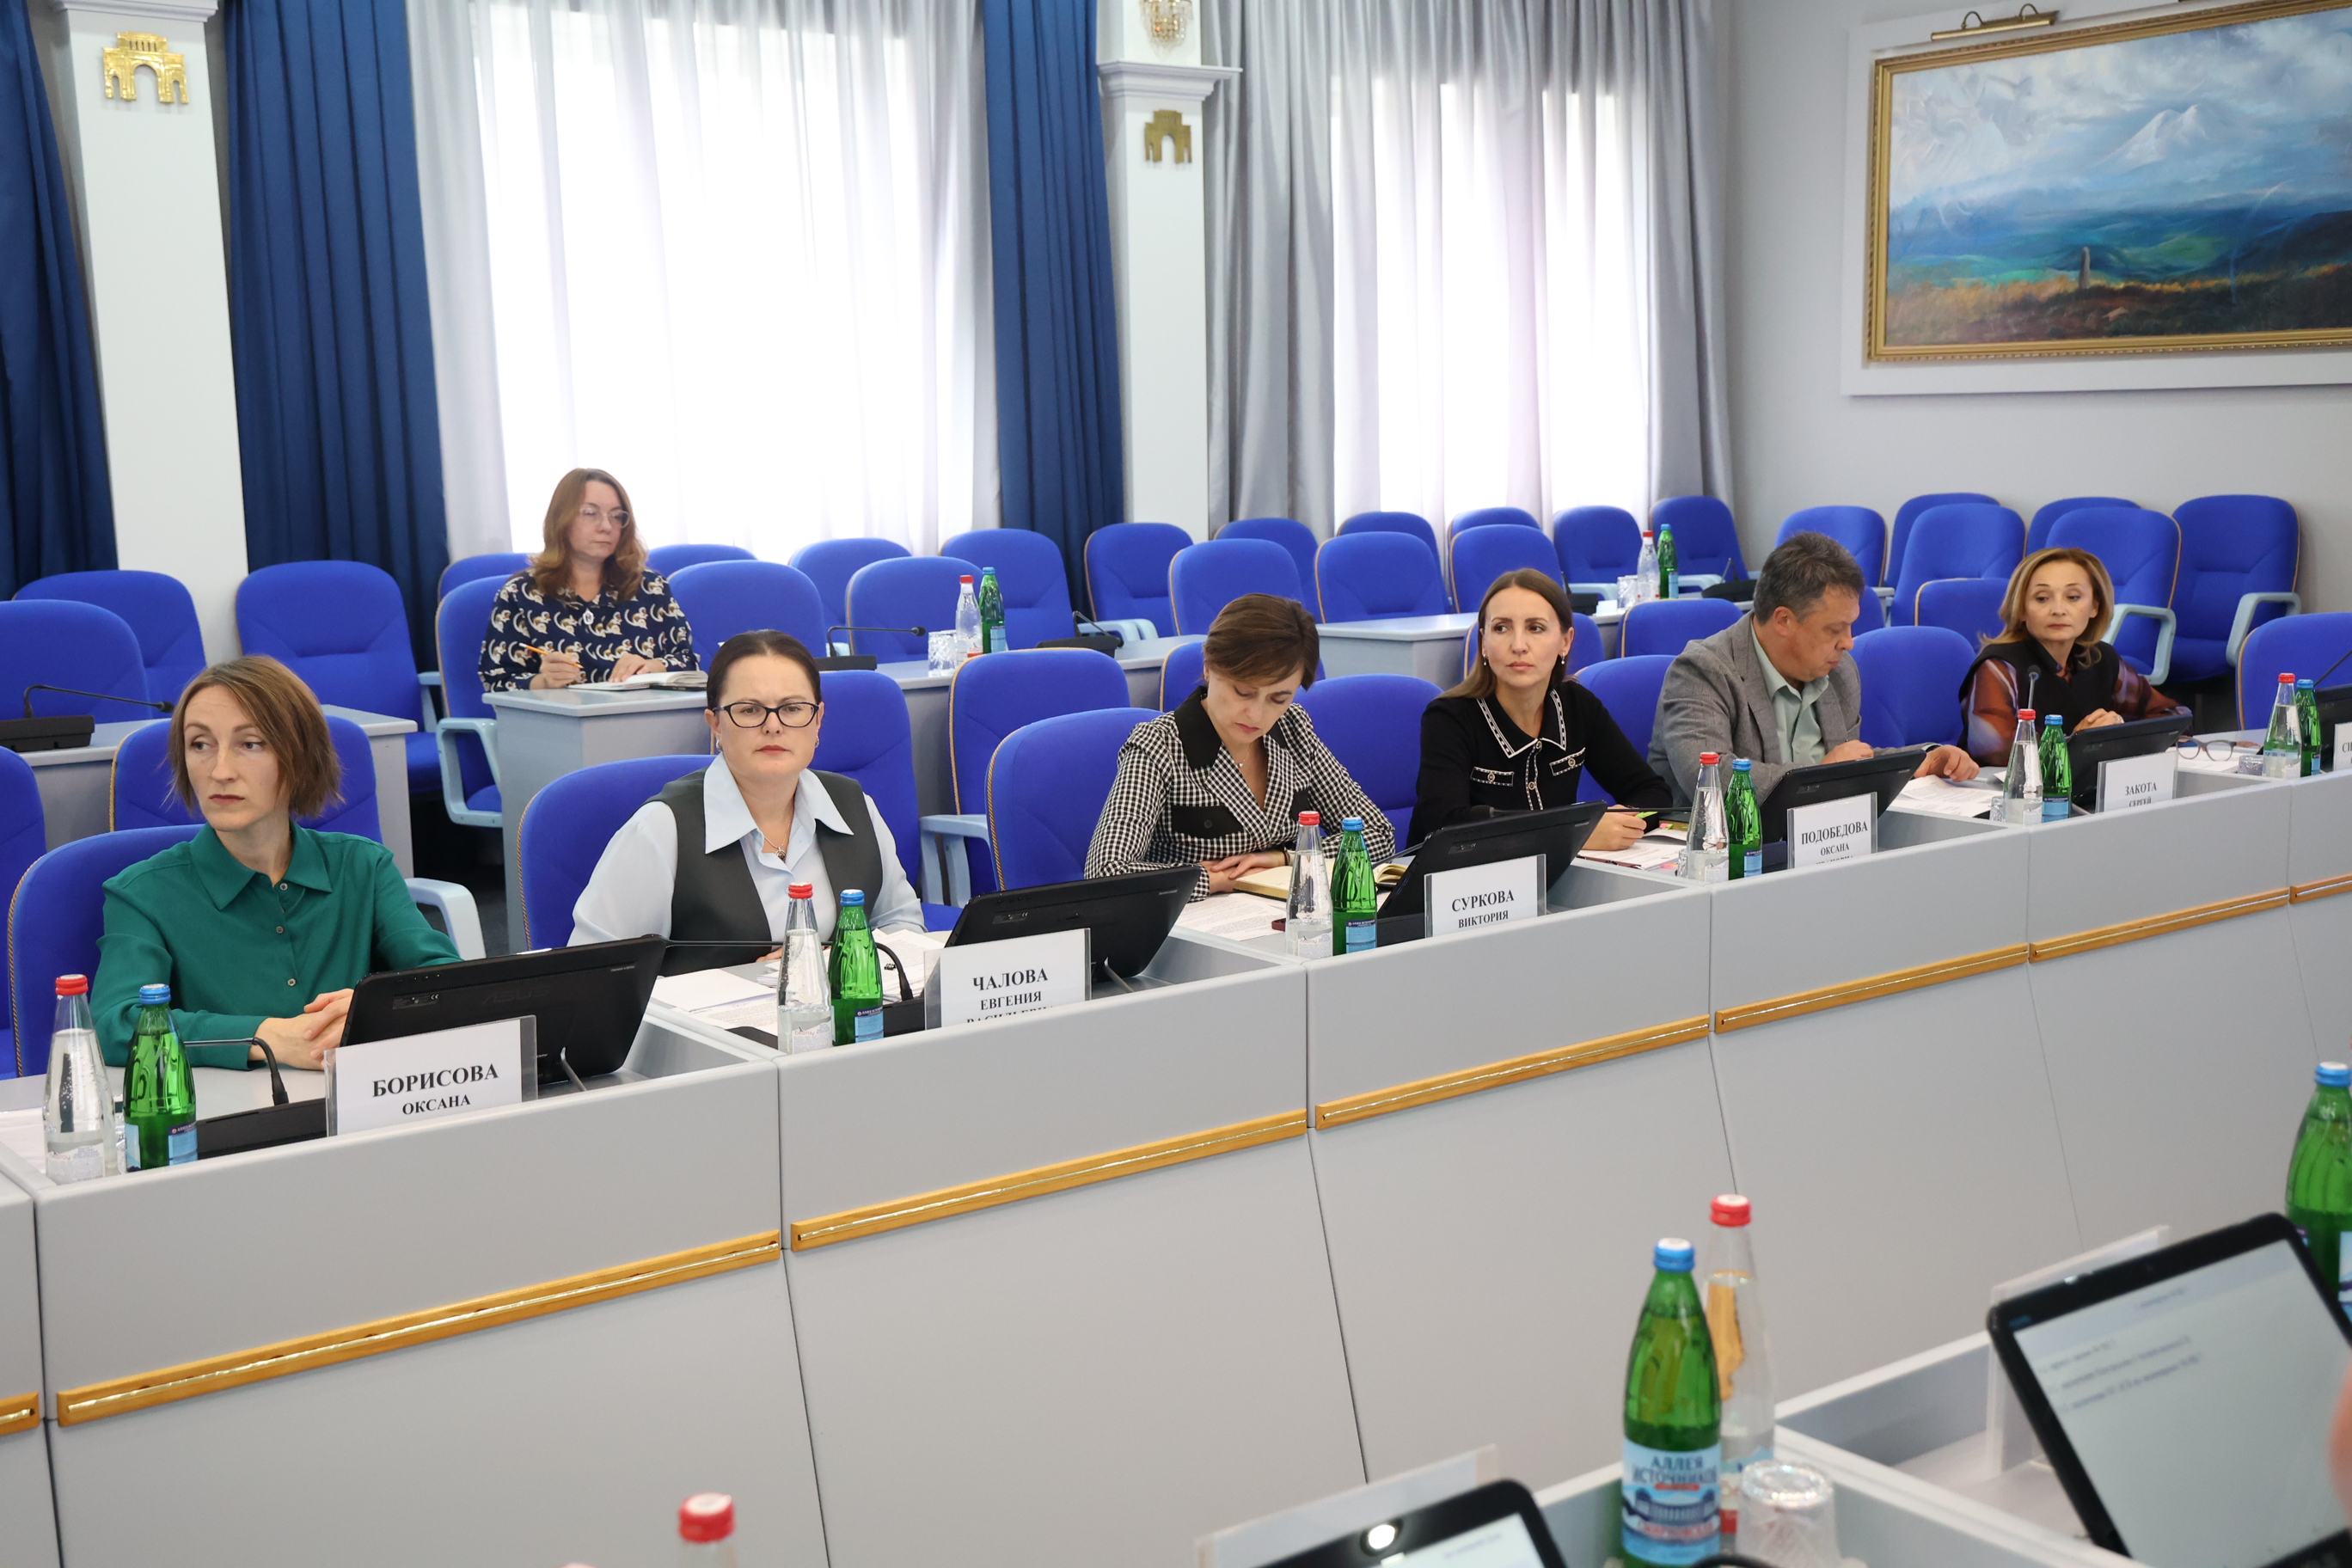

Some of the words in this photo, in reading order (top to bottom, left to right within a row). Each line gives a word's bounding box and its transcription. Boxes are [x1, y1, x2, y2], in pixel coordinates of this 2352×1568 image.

[2124, 782, 2157, 796] ЗАКОТА
[2128, 796, 2152, 807] СЕРГЕЙ
[1801, 821, 1868, 845] ПОДОБЕДОВА
[1820, 842, 1850, 856] ОКСАНА
[1451, 889, 1515, 912] СУРКОВА
[1458, 910, 1509, 928] ВИКТОРИЯ
[972, 968, 1048, 991] ЧАЛОВА
[481, 987, 551, 1006] ASUS
[980, 990, 1042, 1011] ЕВГЕНИЯ
[372, 1063, 499, 1098] БОРИСОВА
[401, 1094, 471, 1116] ОКСАНА
[1651, 1456, 1704, 1471] АЛЛЕЯ
